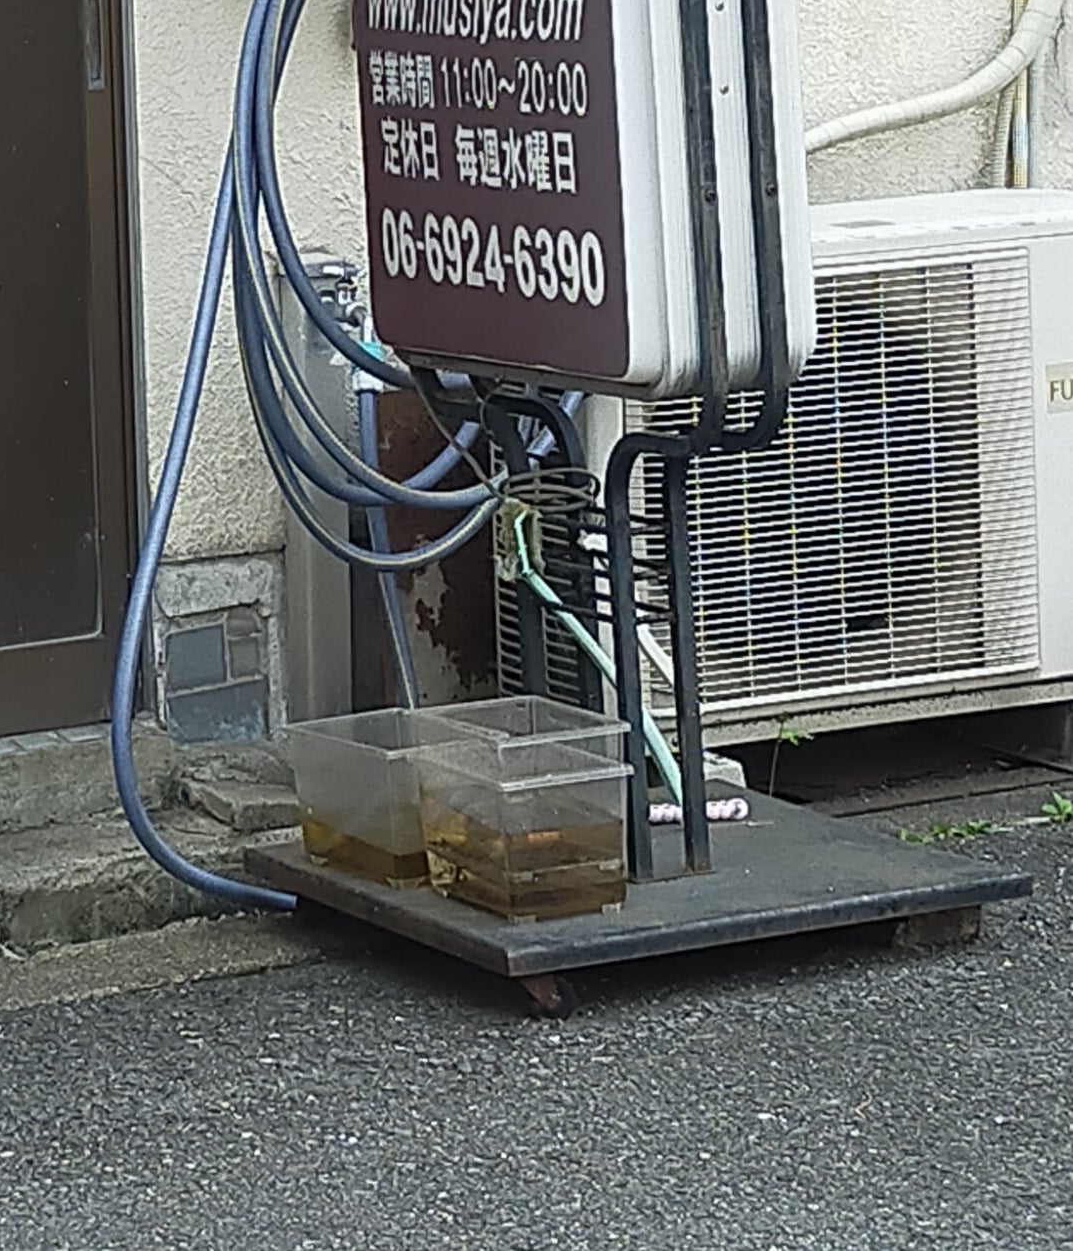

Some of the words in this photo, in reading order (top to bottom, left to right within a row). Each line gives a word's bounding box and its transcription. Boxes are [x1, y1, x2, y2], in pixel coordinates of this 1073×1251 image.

[368, 50, 436, 110] 営業時間
[381, 116, 440, 181] 定休日
[454, 123, 578, 195] 毎週水曜日
[381, 206, 606, 308] 06-6924-6390
